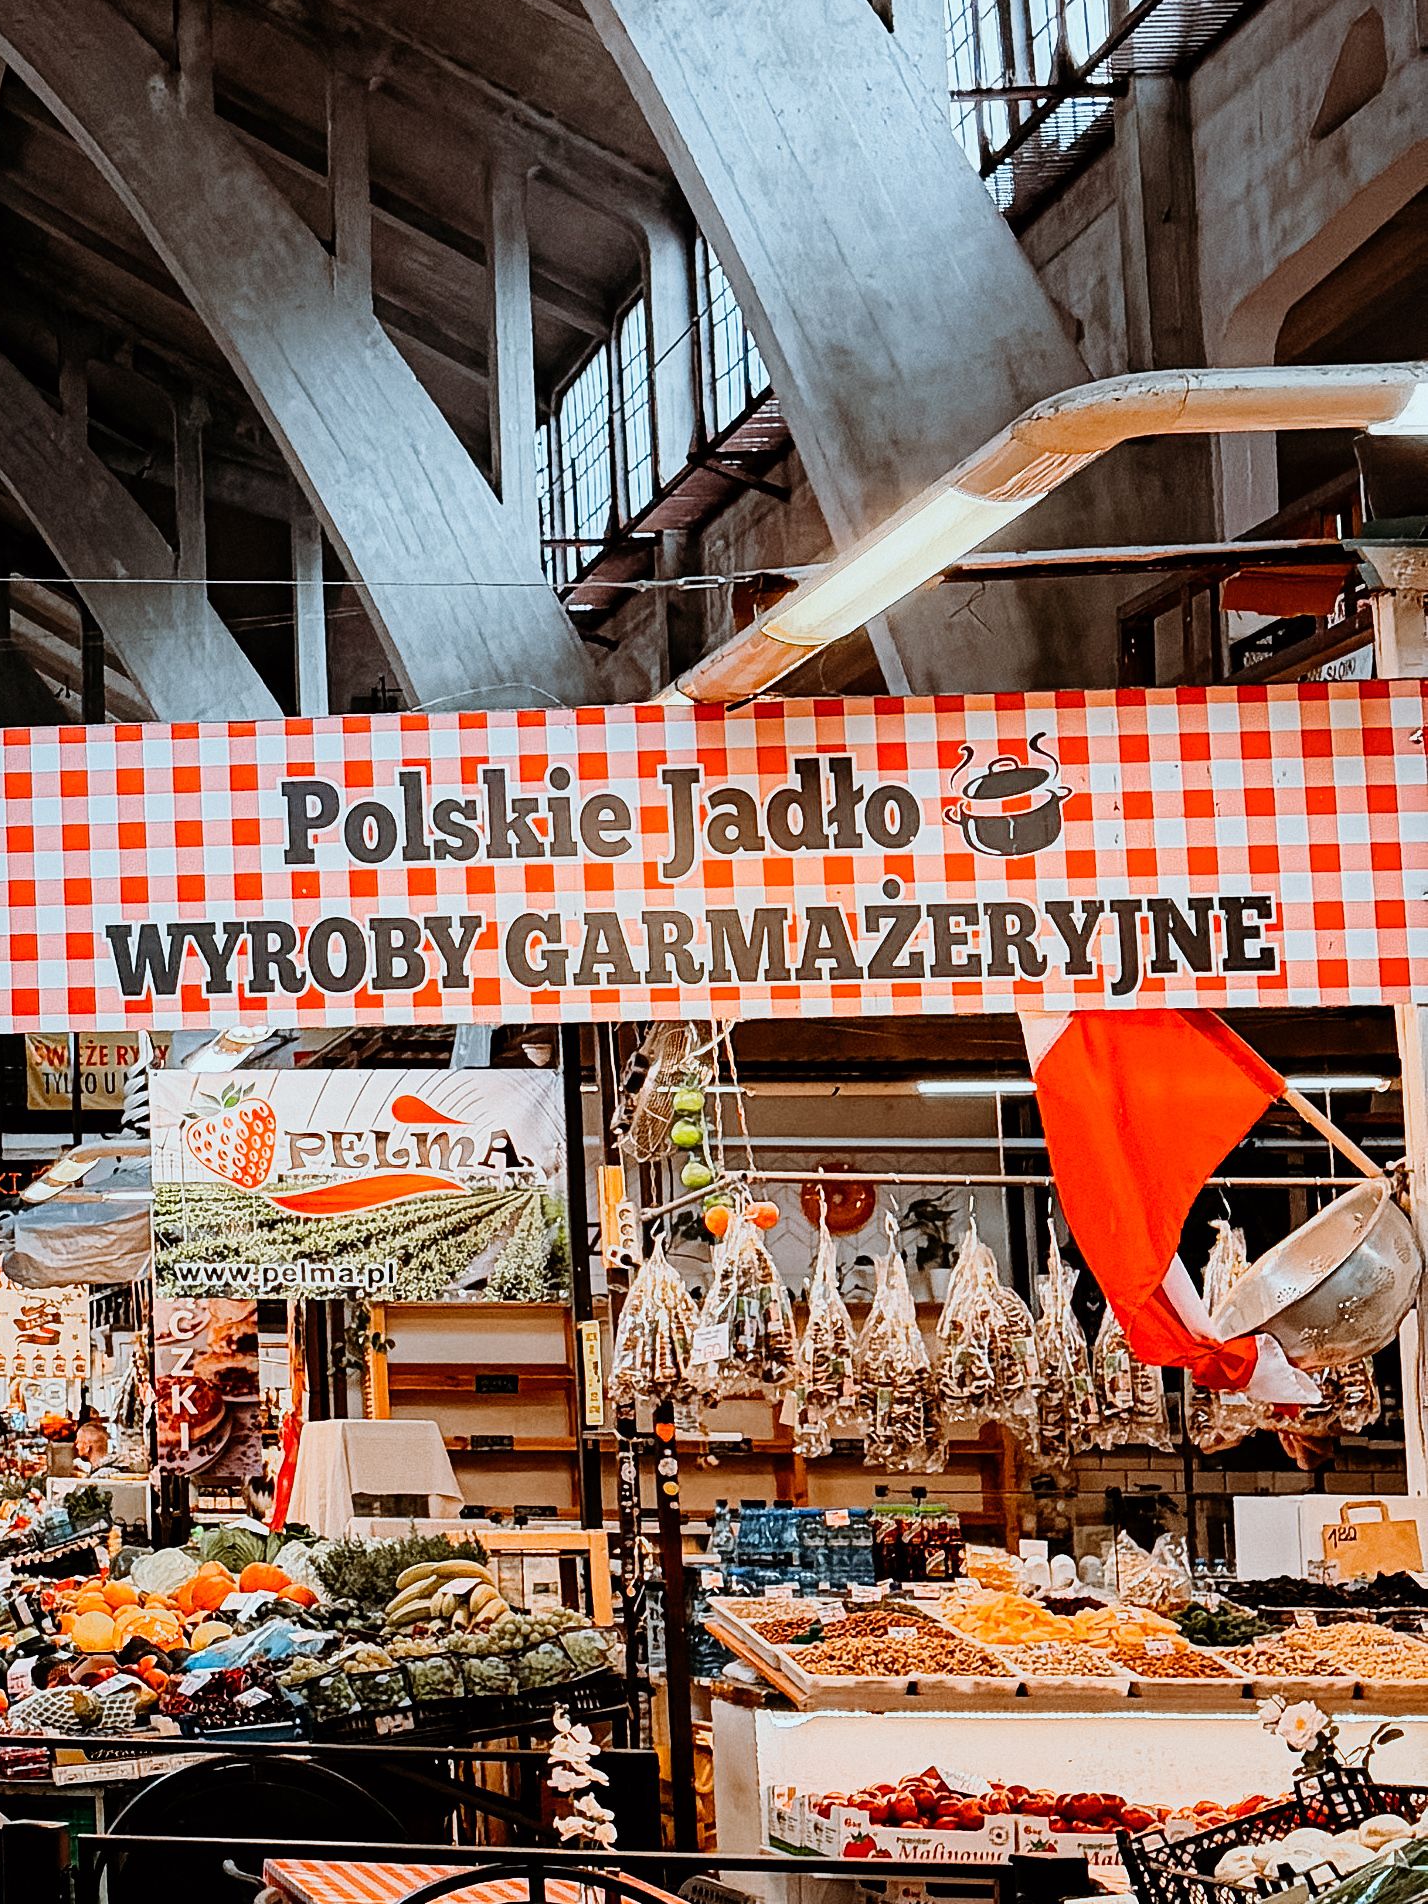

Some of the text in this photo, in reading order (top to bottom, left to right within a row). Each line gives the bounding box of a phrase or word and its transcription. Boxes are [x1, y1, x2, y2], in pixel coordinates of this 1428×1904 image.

[283, 756, 921, 879] Polskie Jadło
[107, 879, 1276, 995] WYROBY GARMAŻERYJNE
[42, 1072, 97, 1094] TYLO
[104, 1072, 115, 1094] U
[117, 1045, 170, 1067] RYY
[176, 1261, 397, 1289] www.pelma.pl
[169, 1299, 198, 1451] CZKI
